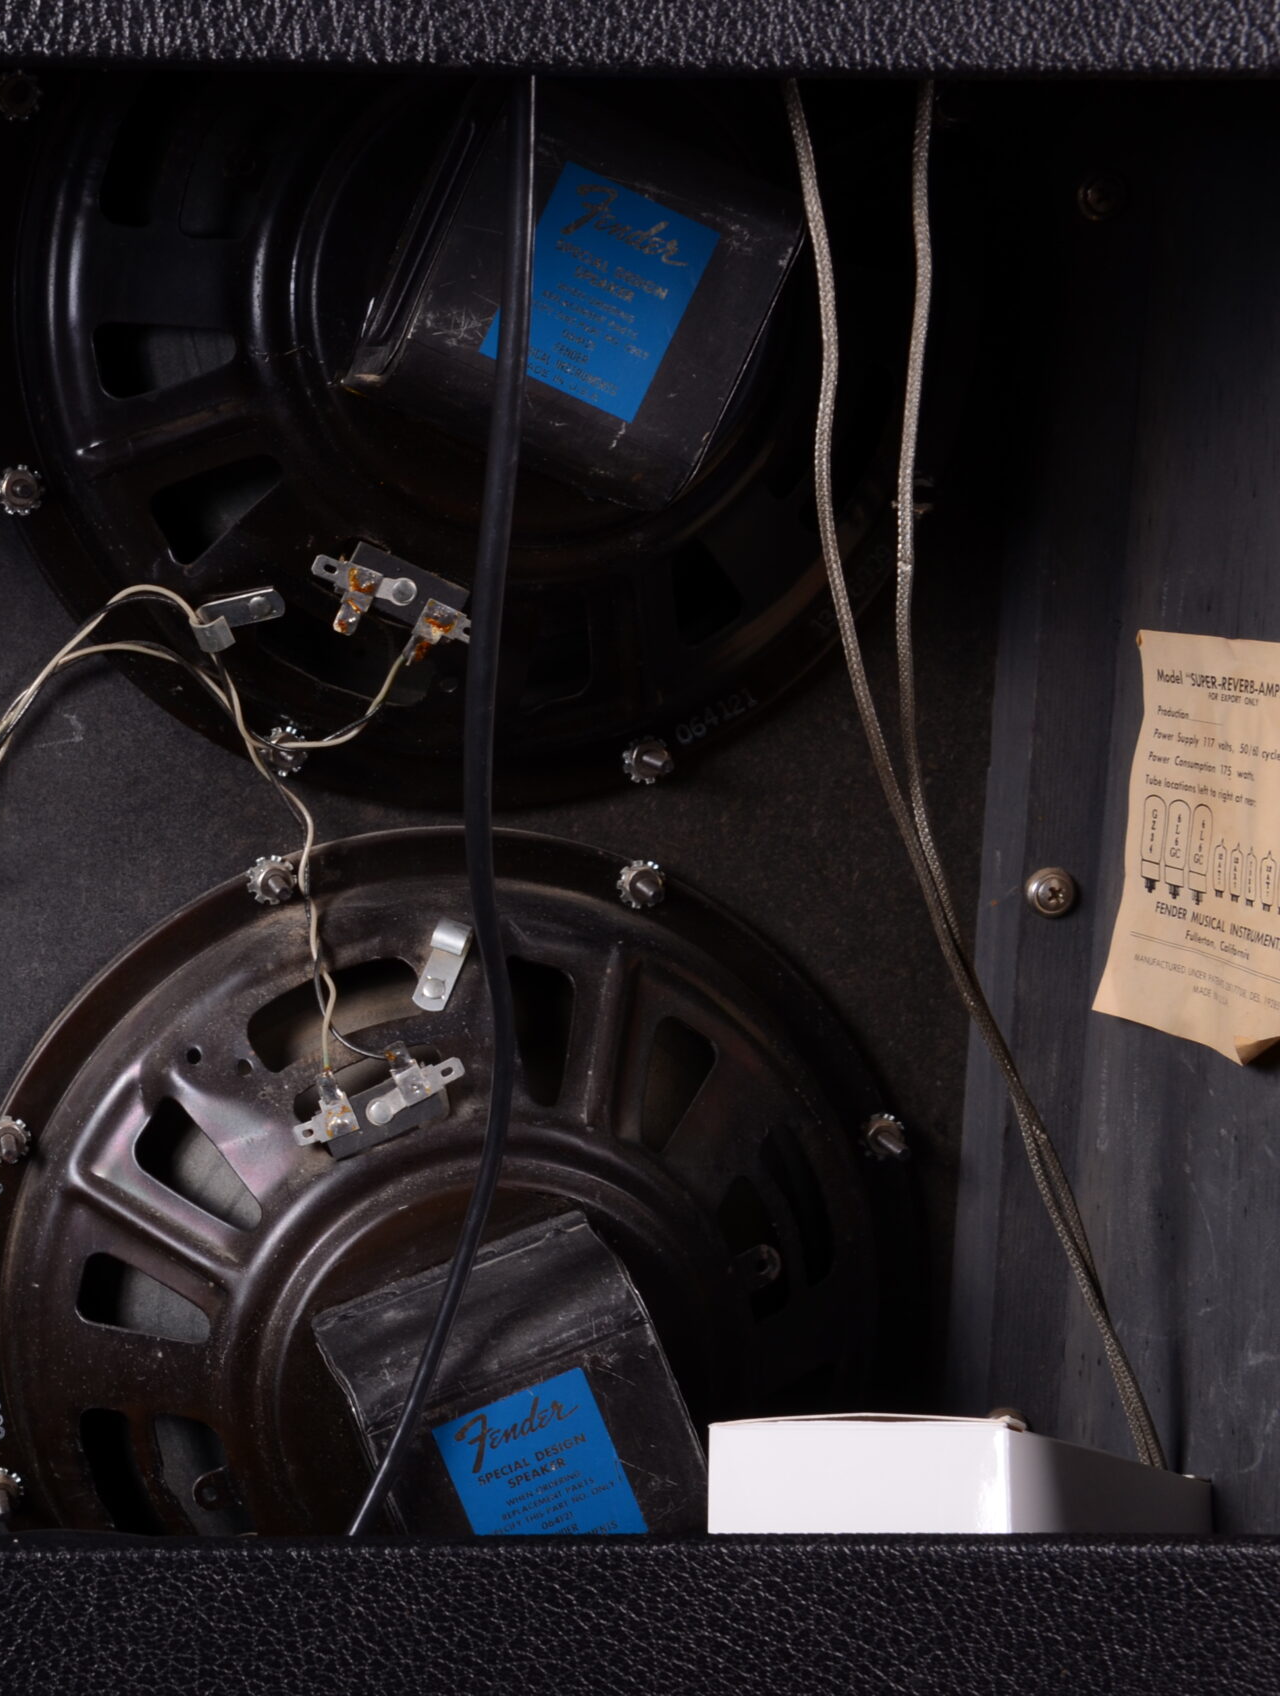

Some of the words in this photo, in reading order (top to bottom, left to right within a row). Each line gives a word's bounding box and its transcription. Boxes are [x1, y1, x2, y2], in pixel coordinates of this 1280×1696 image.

[560, 184, 688, 267] Fender
[1157, 669, 1183, 685] Model
[1157, 705, 1189, 719] Production
[1221, 693, 1241, 703] EXPORT
[1244, 697, 1259, 706] ONLY
[1153, 728, 1174, 741] Power
[1178, 732, 1199, 748] Supply
[1204, 737, 1215, 748] 117
[1148, 751, 1170, 764] Power
[1175, 755, 1216, 773] Consumption
[1220, 764, 1232, 776] 175
[1146, 774, 1161, 786] Tube
[1164, 778, 1196, 793] locations
[1155, 901, 1188, 920] FENDER
[1191, 911, 1225, 933] MUSICAL
[1230, 922, 1280, 951] INSTRUMENT
[454, 1397, 580, 1474] Fender
[478, 1457, 530, 1485] SPECIAL
[535, 1433, 586, 1461] DESIGN
[507, 1457, 566, 1488] SPEAKER
